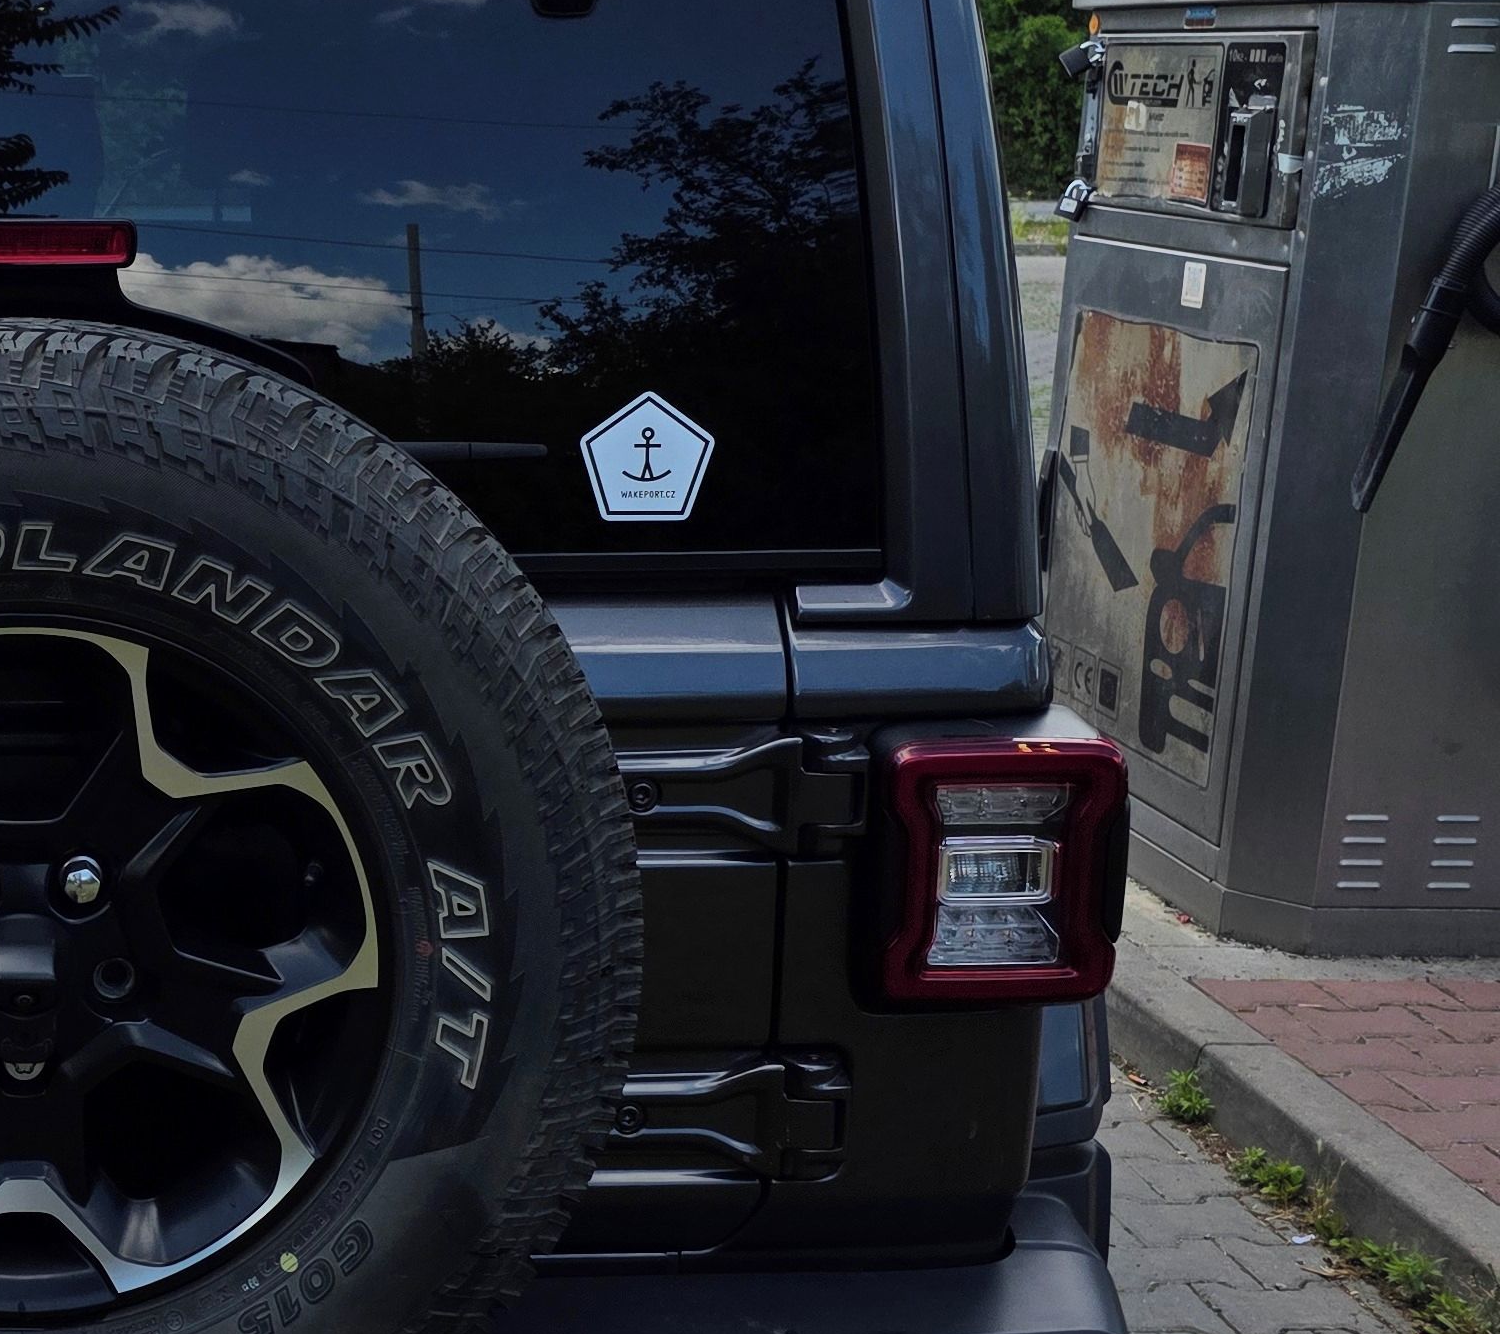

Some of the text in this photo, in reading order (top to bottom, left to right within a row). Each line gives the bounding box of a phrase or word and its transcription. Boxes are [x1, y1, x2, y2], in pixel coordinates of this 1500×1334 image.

[620, 490, 676, 498] WAKEPORT.CZ
[426, 859, 492, 1090] A/T
[367, 1117, 391, 1150] DOT
